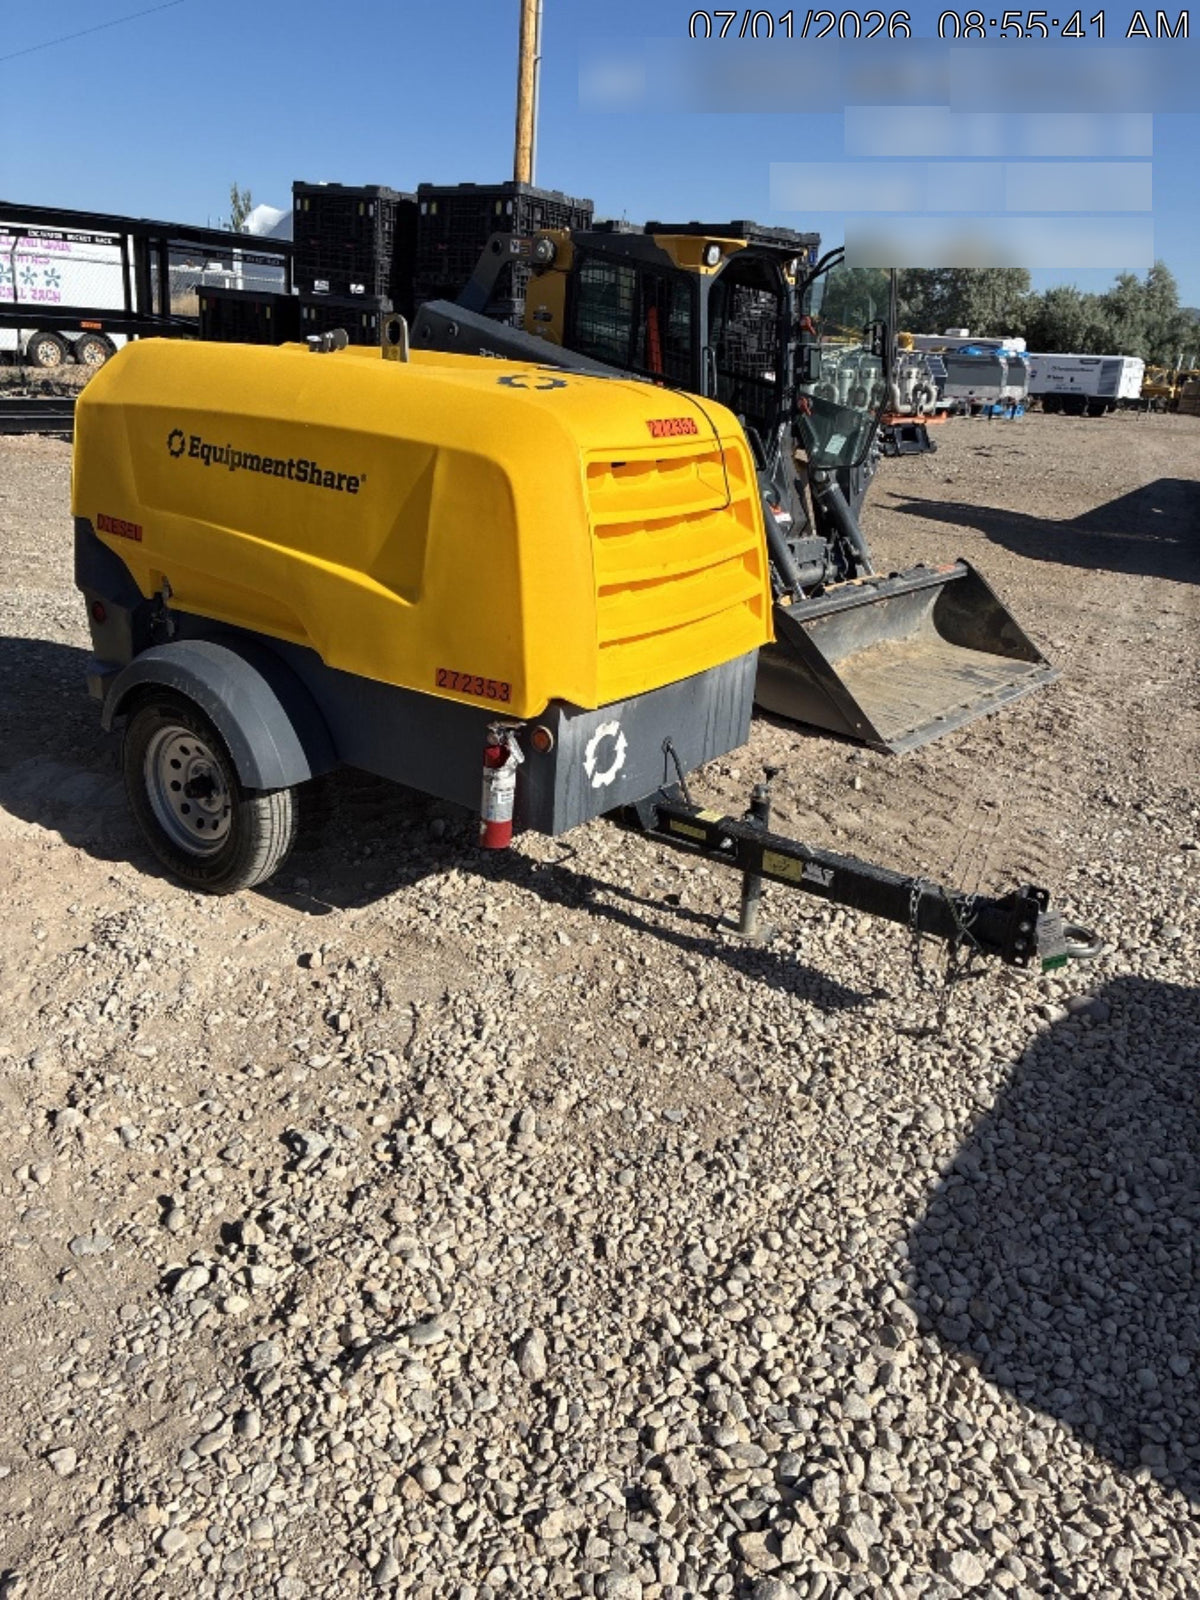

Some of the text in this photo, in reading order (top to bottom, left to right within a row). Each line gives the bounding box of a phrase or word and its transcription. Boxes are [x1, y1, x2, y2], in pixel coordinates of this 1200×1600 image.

[645, 417, 698, 437] 272353
[97, 513, 142, 542] DIESEL
[438, 668, 510, 702] 272353
